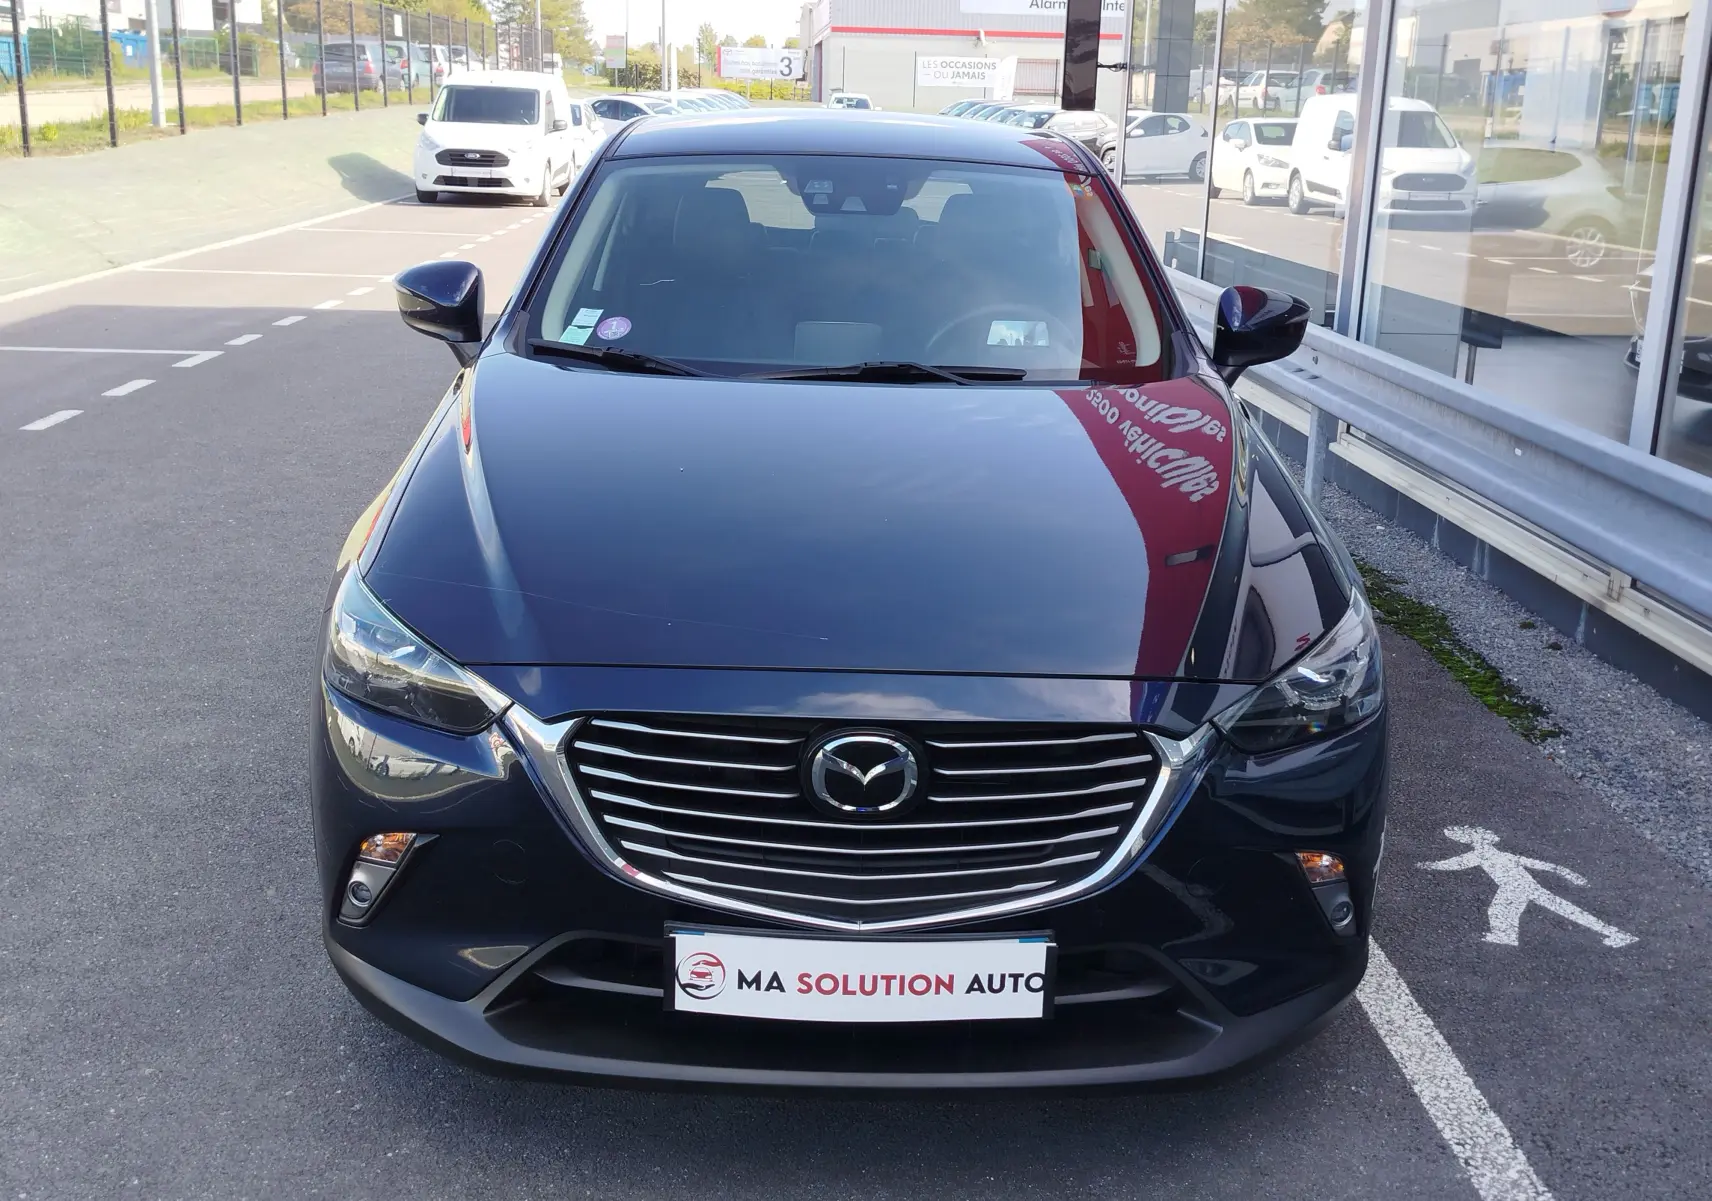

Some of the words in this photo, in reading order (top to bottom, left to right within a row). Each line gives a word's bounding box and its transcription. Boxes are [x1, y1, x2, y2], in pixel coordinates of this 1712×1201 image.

[780, 57, 793, 76] 3
[922, 60, 938, 69] LES
[940, 60, 997, 70] OCCASIONS
[933, 71, 949, 79] OU
[950, 71, 986, 80] JAMAIS
[737, 968, 786, 993] MA
[796, 972, 955, 996] SOLUTION
[965, 972, 1045, 994] AUTO
